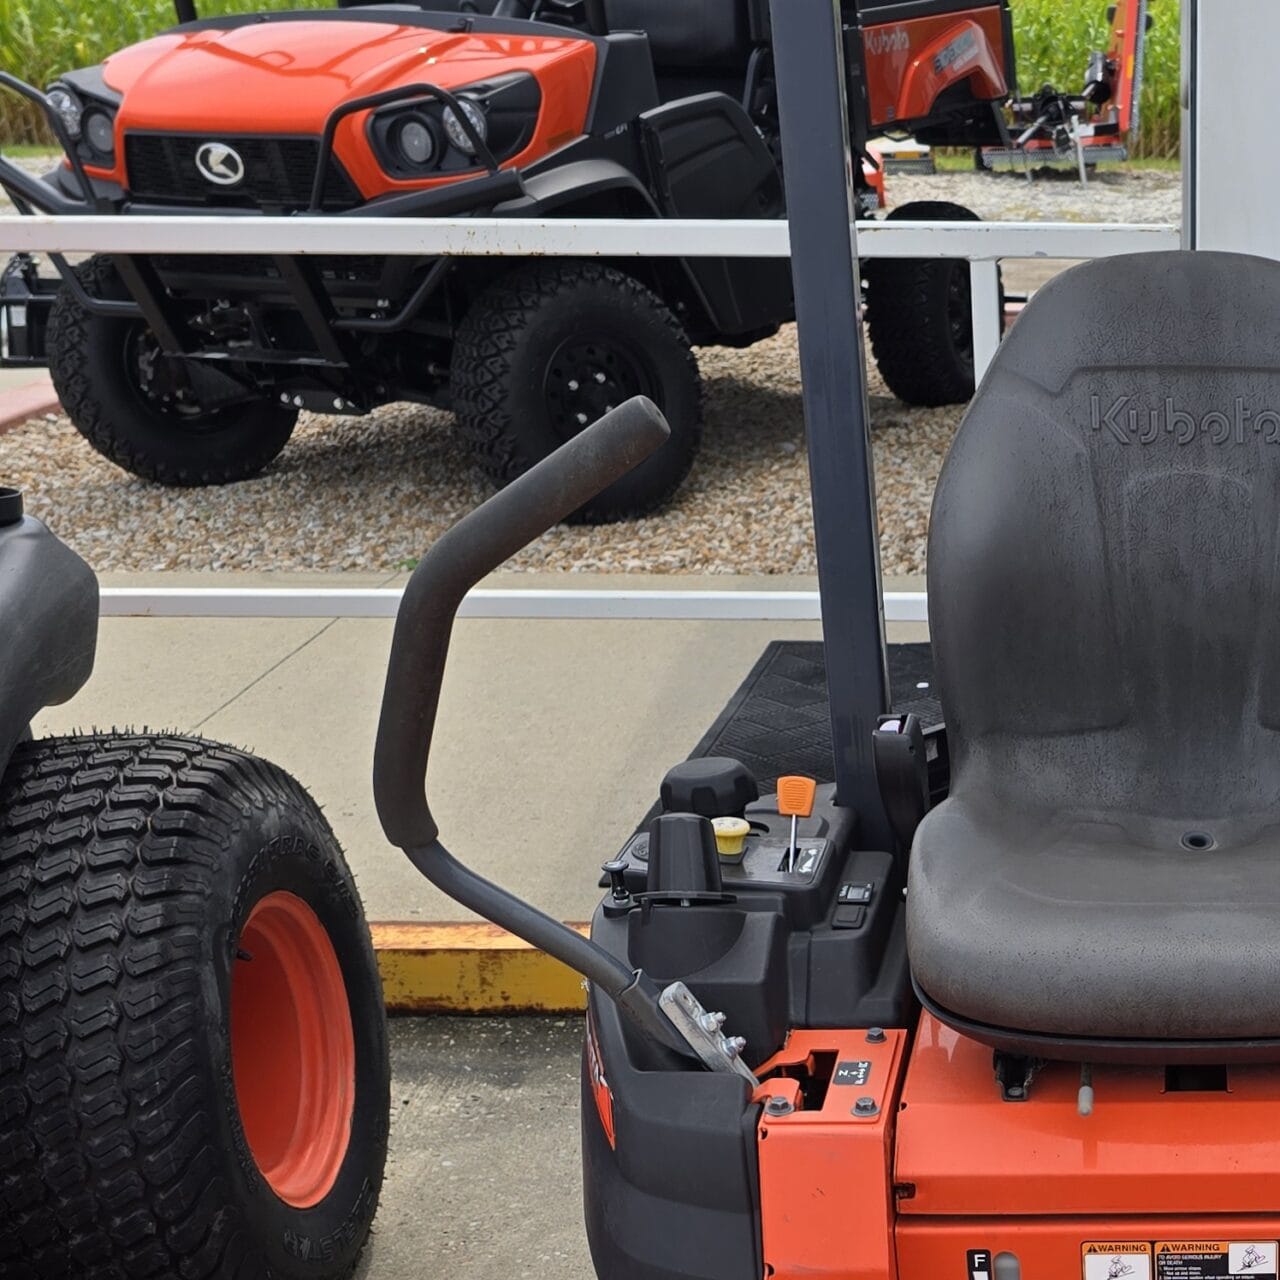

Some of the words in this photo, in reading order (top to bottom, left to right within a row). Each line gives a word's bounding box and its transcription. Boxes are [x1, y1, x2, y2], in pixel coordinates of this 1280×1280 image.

[1098, 1244, 1147, 1252] WARNING
[1171, 1243, 1220, 1251] WARNING
[974, 1254, 986, 1267] F
